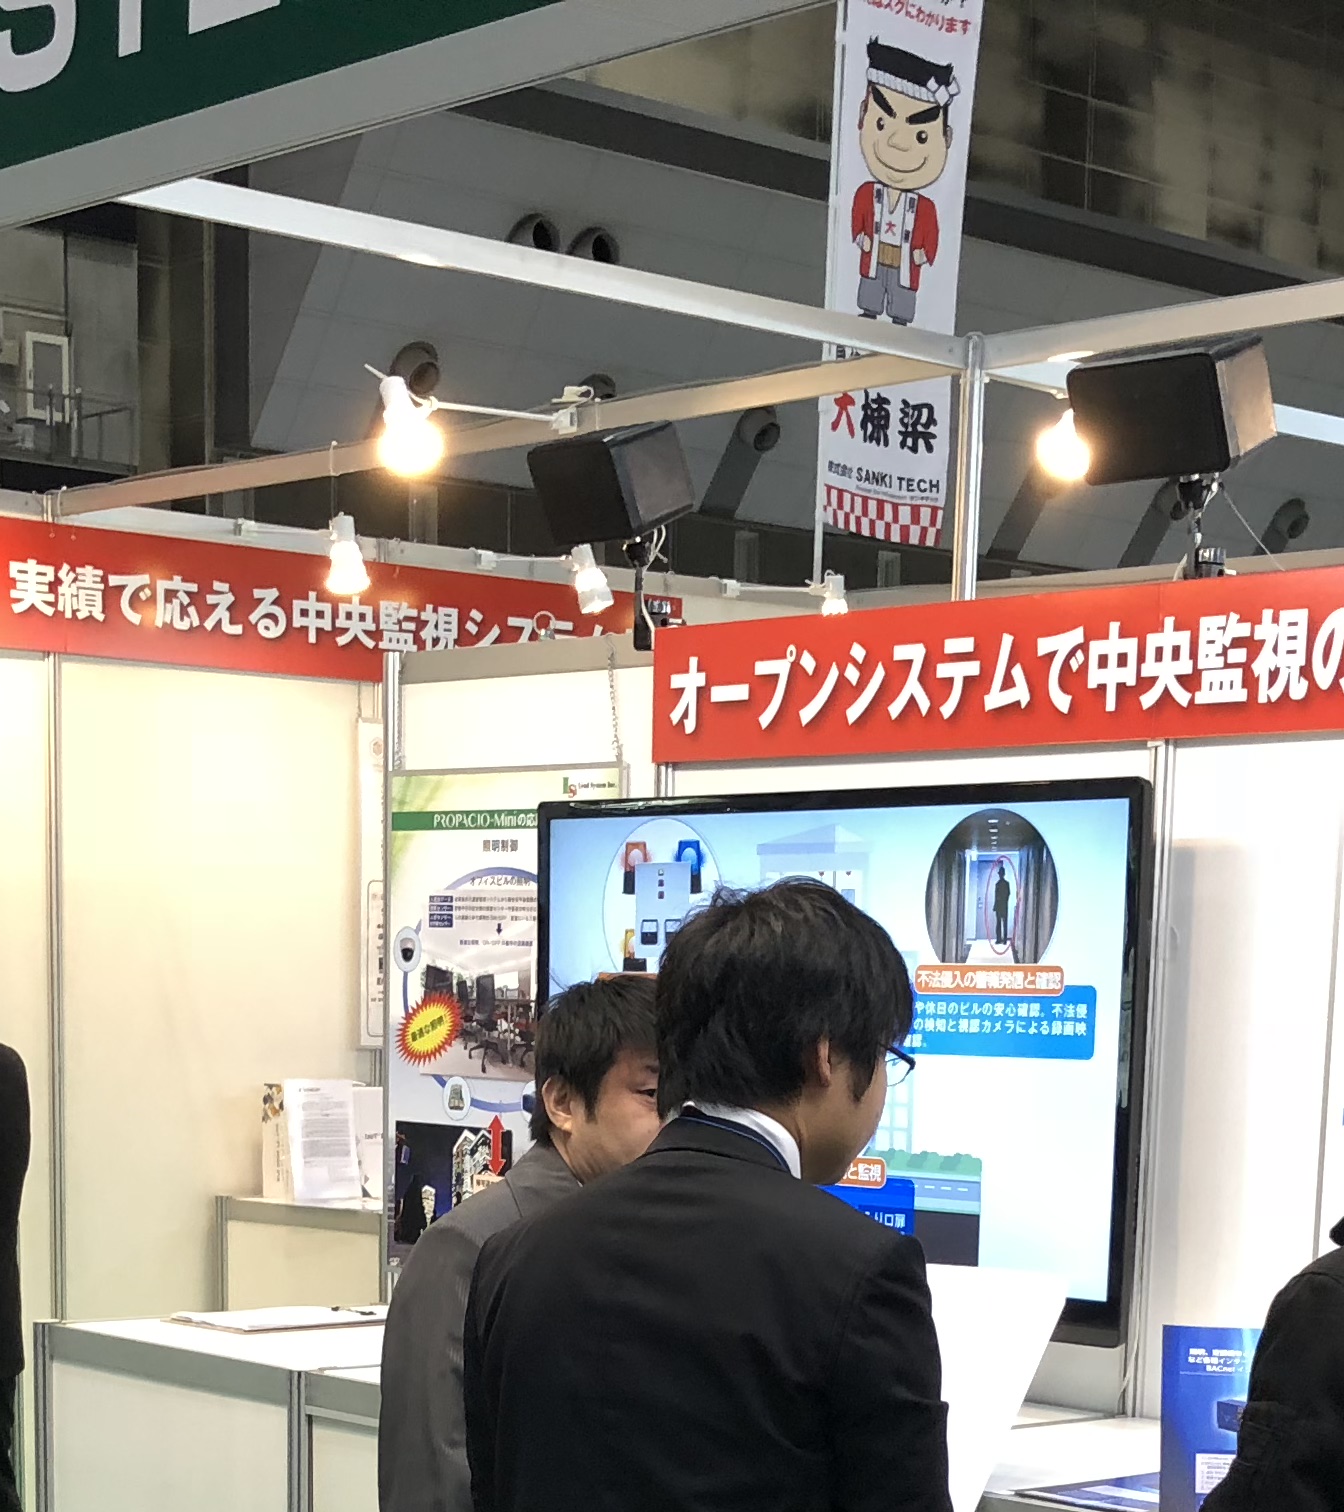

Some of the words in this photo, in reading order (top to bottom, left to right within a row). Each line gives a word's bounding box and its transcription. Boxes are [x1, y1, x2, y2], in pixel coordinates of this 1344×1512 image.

[855, 466, 893, 490] SANKI
[897, 475, 941, 495] TECH
[432, 810, 538, 830] PROPACIO-Miniの応
[842, 1163, 882, 1182] と監視
